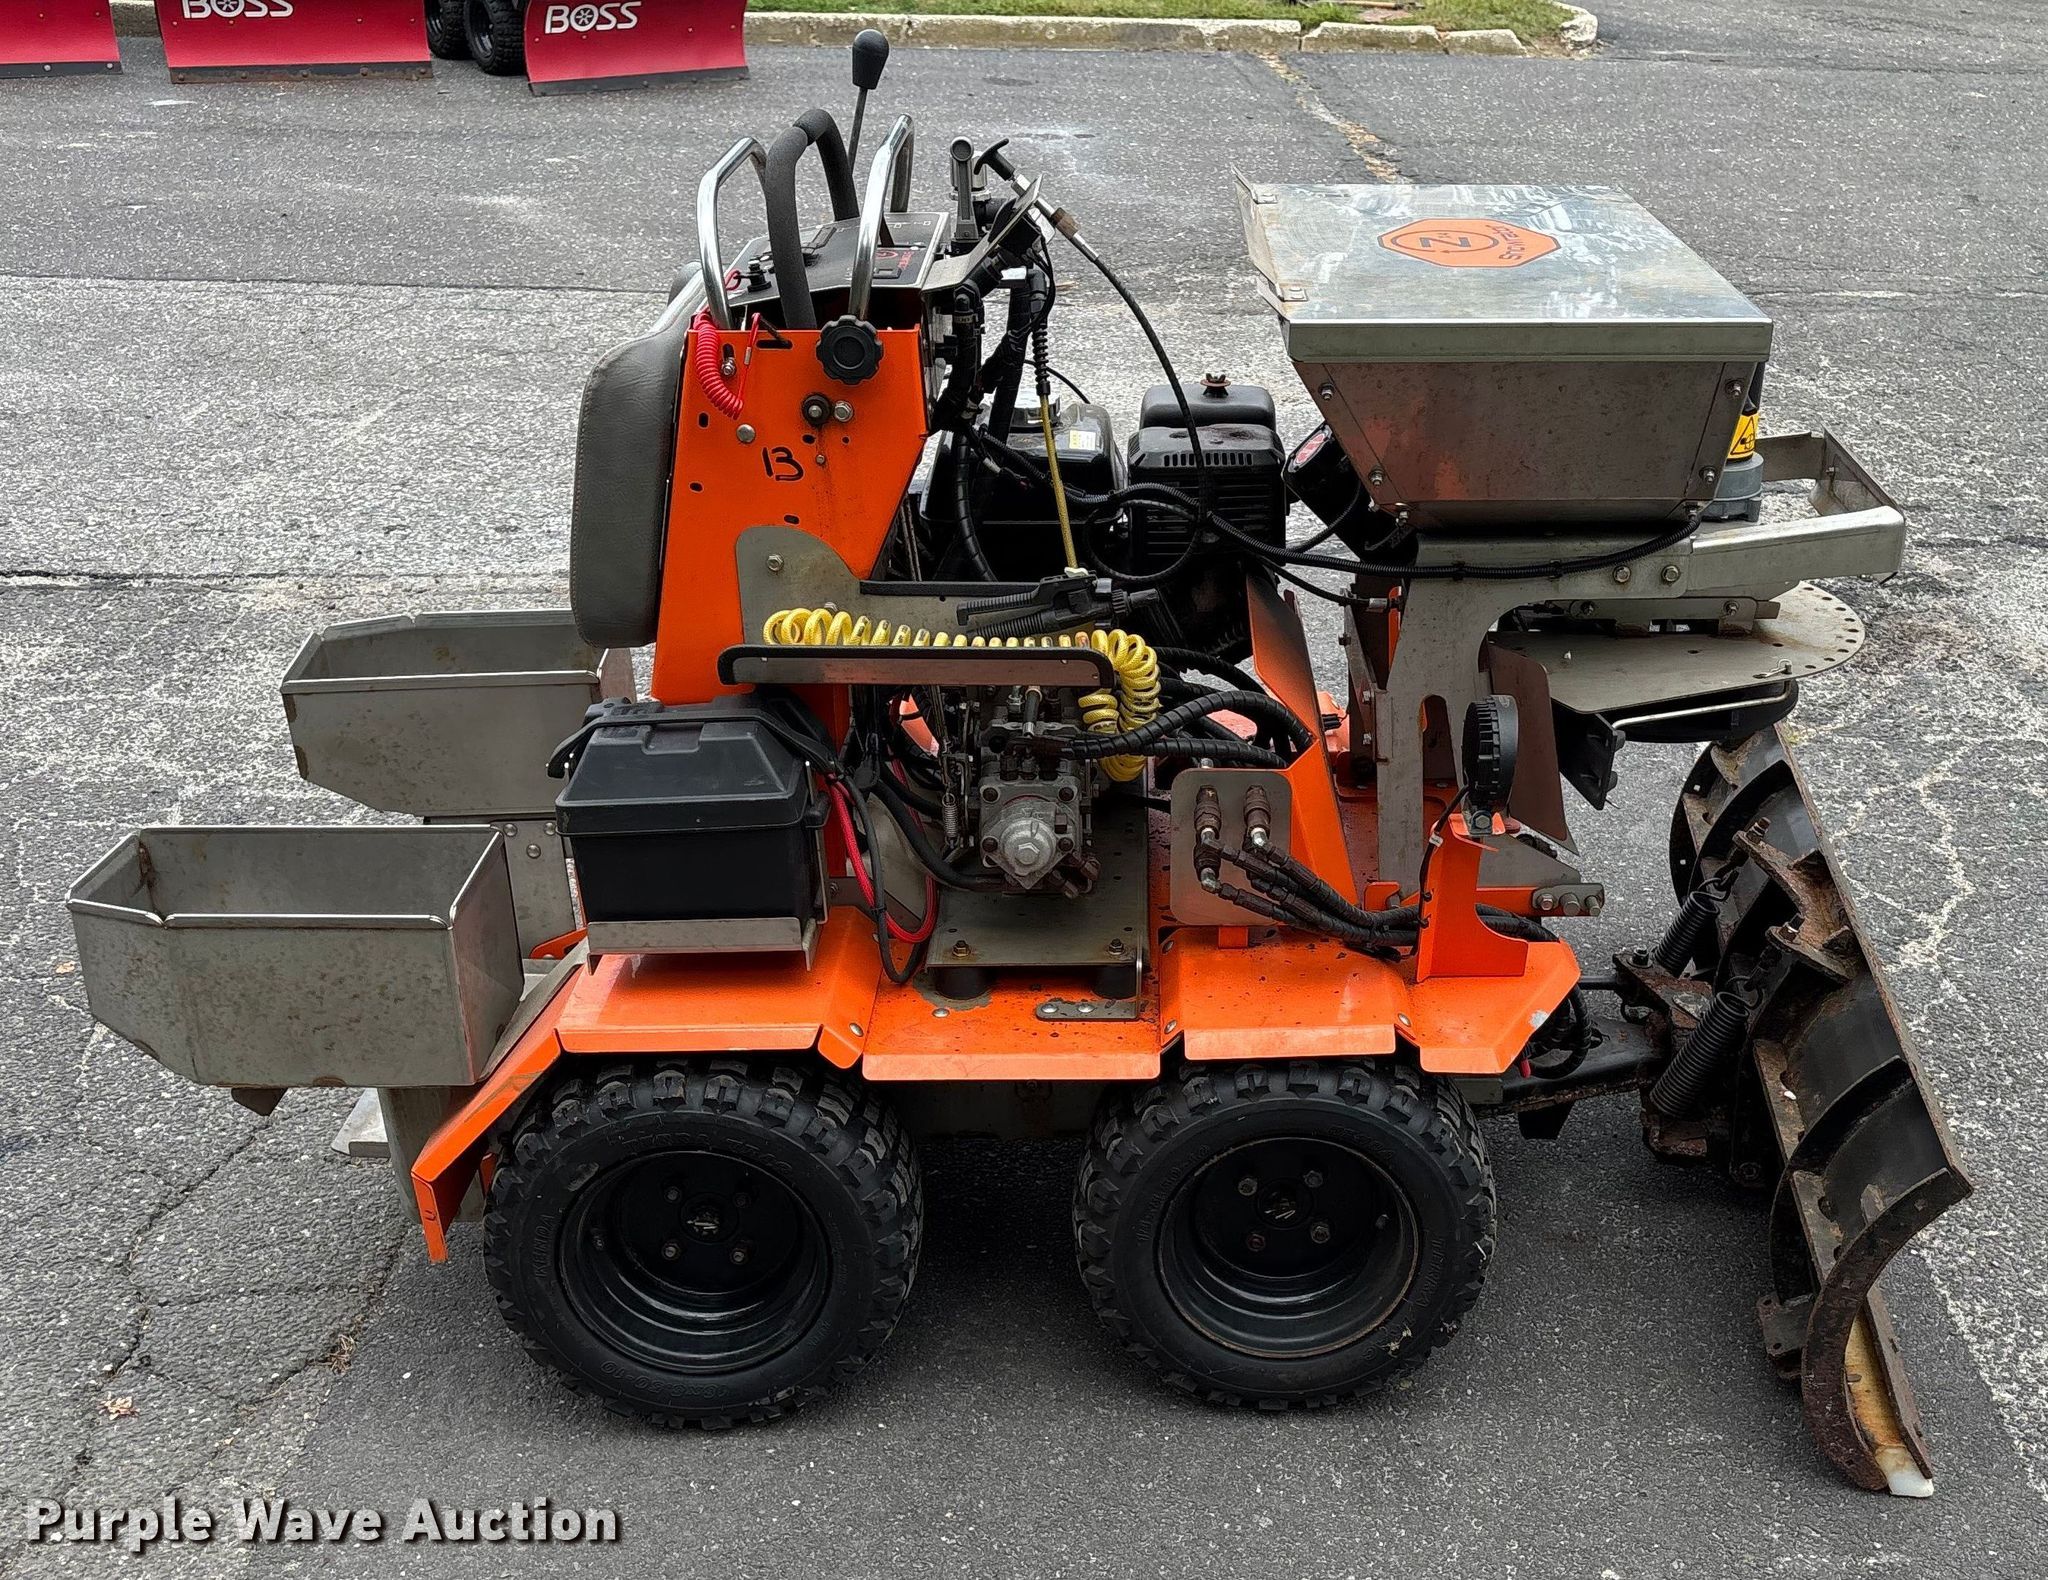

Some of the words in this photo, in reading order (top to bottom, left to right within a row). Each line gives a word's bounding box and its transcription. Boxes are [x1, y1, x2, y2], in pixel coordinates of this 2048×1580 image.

[182, 0, 294, 19] BOSS
[544, 1, 642, 34] BOSS
[762, 446, 804, 482] 13
